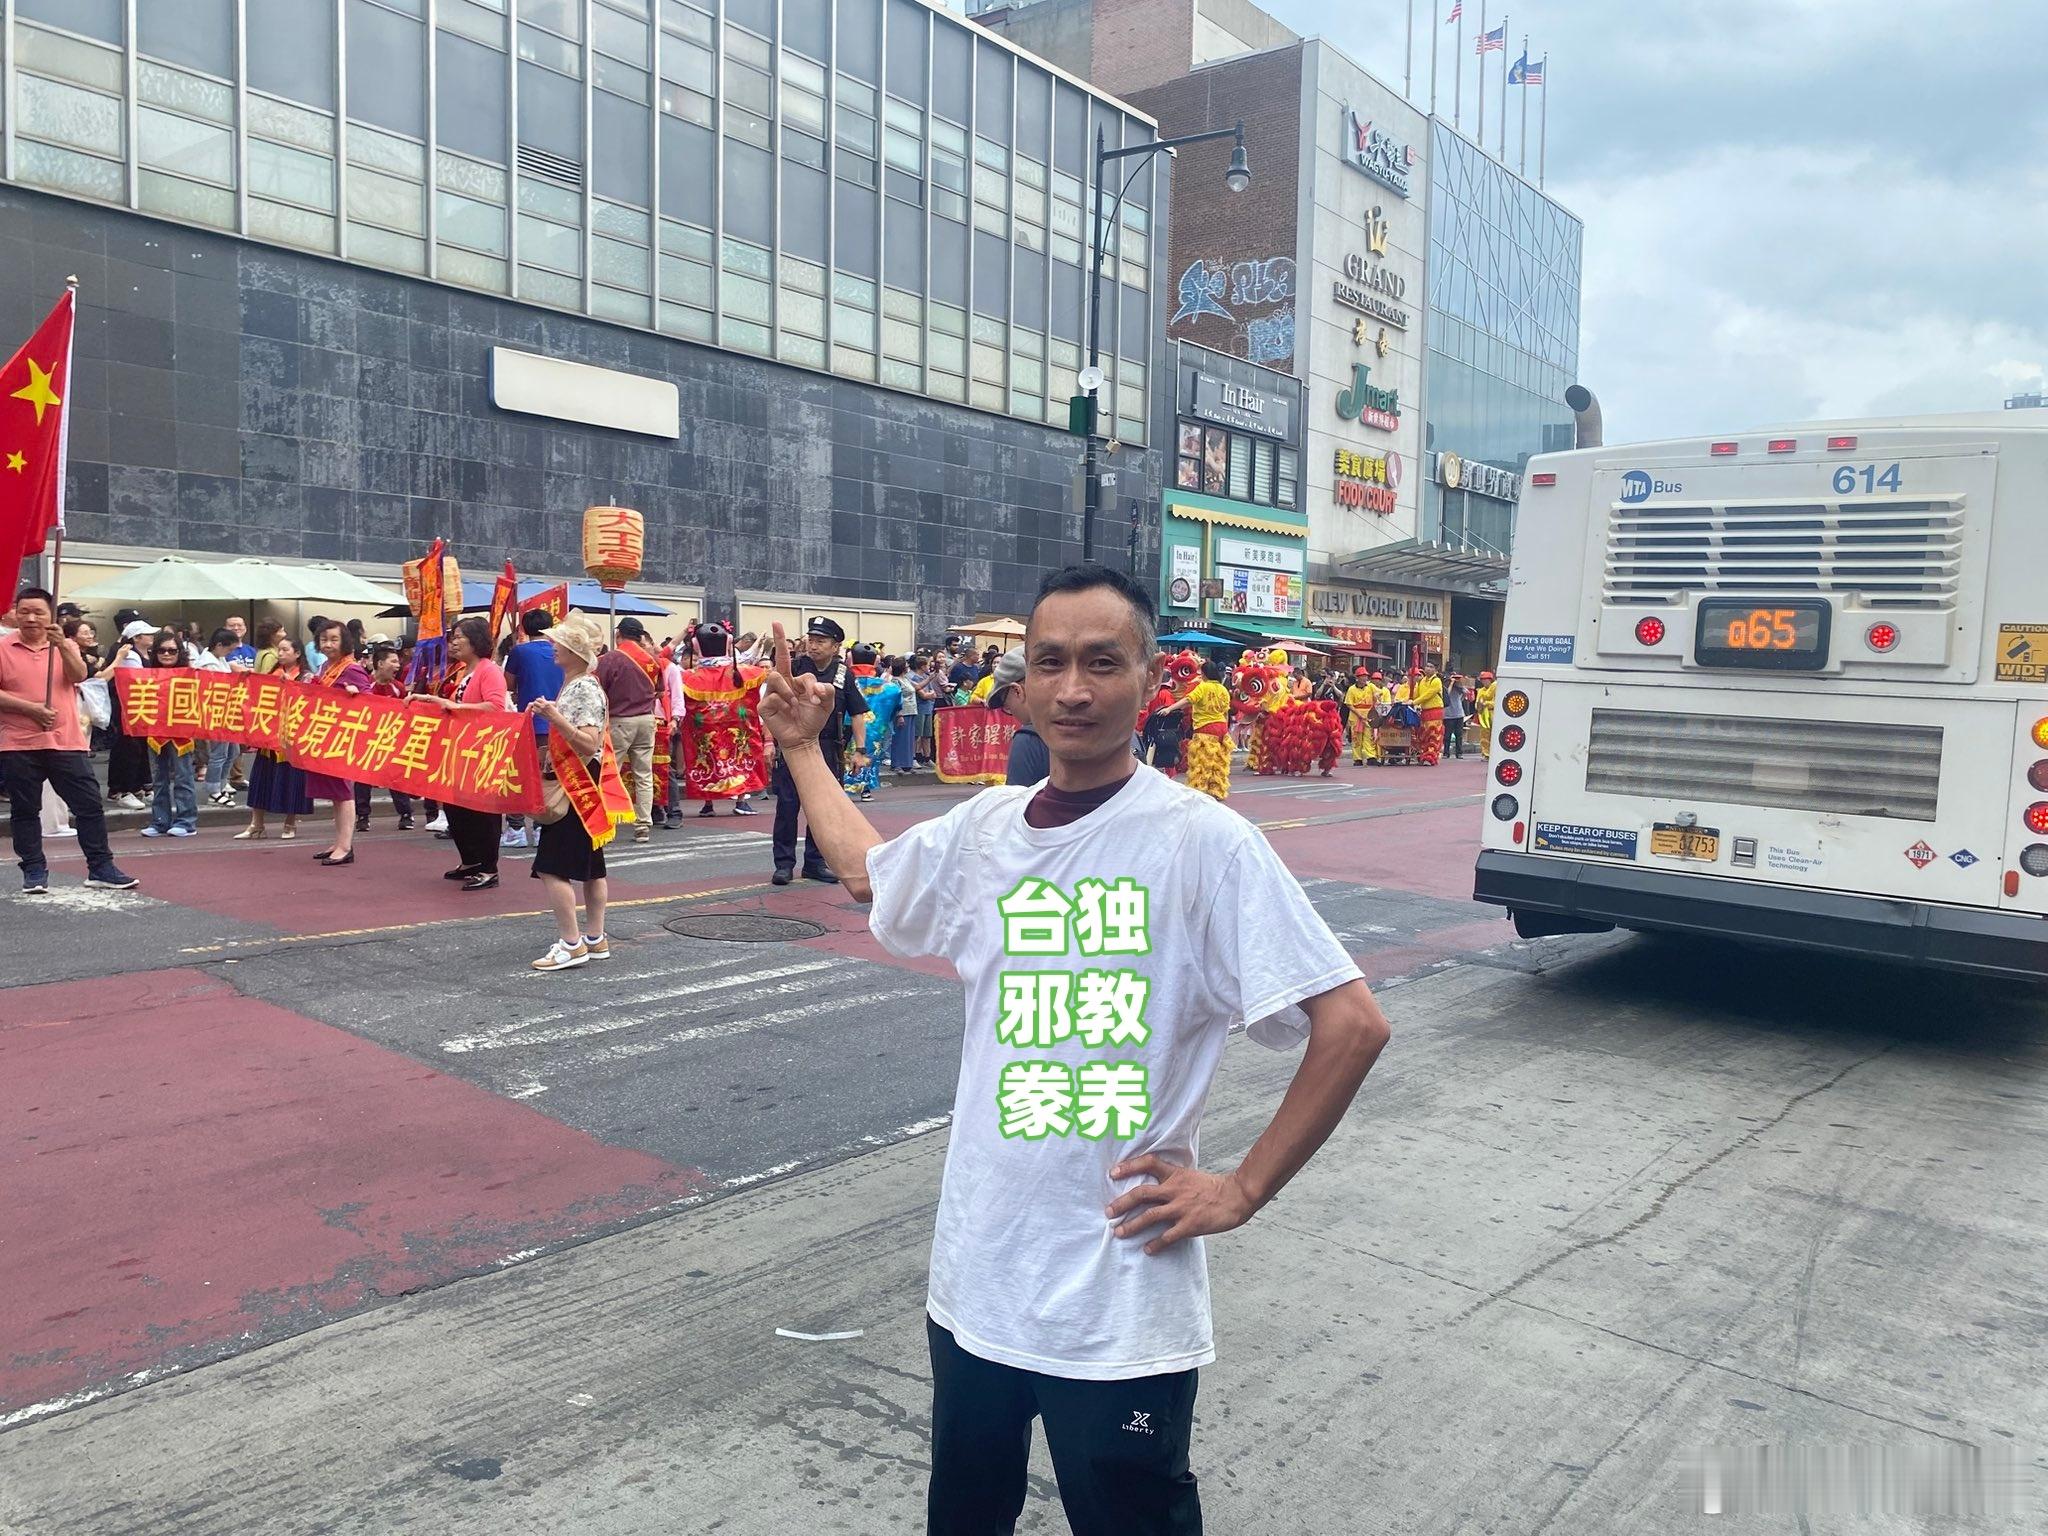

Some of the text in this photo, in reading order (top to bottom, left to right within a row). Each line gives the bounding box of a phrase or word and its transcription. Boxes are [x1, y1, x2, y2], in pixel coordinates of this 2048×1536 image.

[1344, 253, 1405, 299] GRAND
[1334, 282, 1408, 326] RESTAURANT
[1222, 383, 1264, 413] In Hair
[1654, 480, 1682, 493] Bus
[1832, 464, 1902, 494] 614
[1337, 480, 1397, 513] FOOD COURT
[1315, 591, 1349, 612] NEW
[1354, 594, 1404, 617] WORLD
[1408, 601, 1440, 620] MALL
[1999, 664, 2046, 676] WIDE
[1537, 823, 1636, 841] KEEP CLEAR OF BUSES
[1788, 856, 1822, 865] Clean-Air
[1913, 850, 1929, 859] 1971
[1954, 854, 1973, 863] CNG
[1768, 861, 1808, 872] Technology
